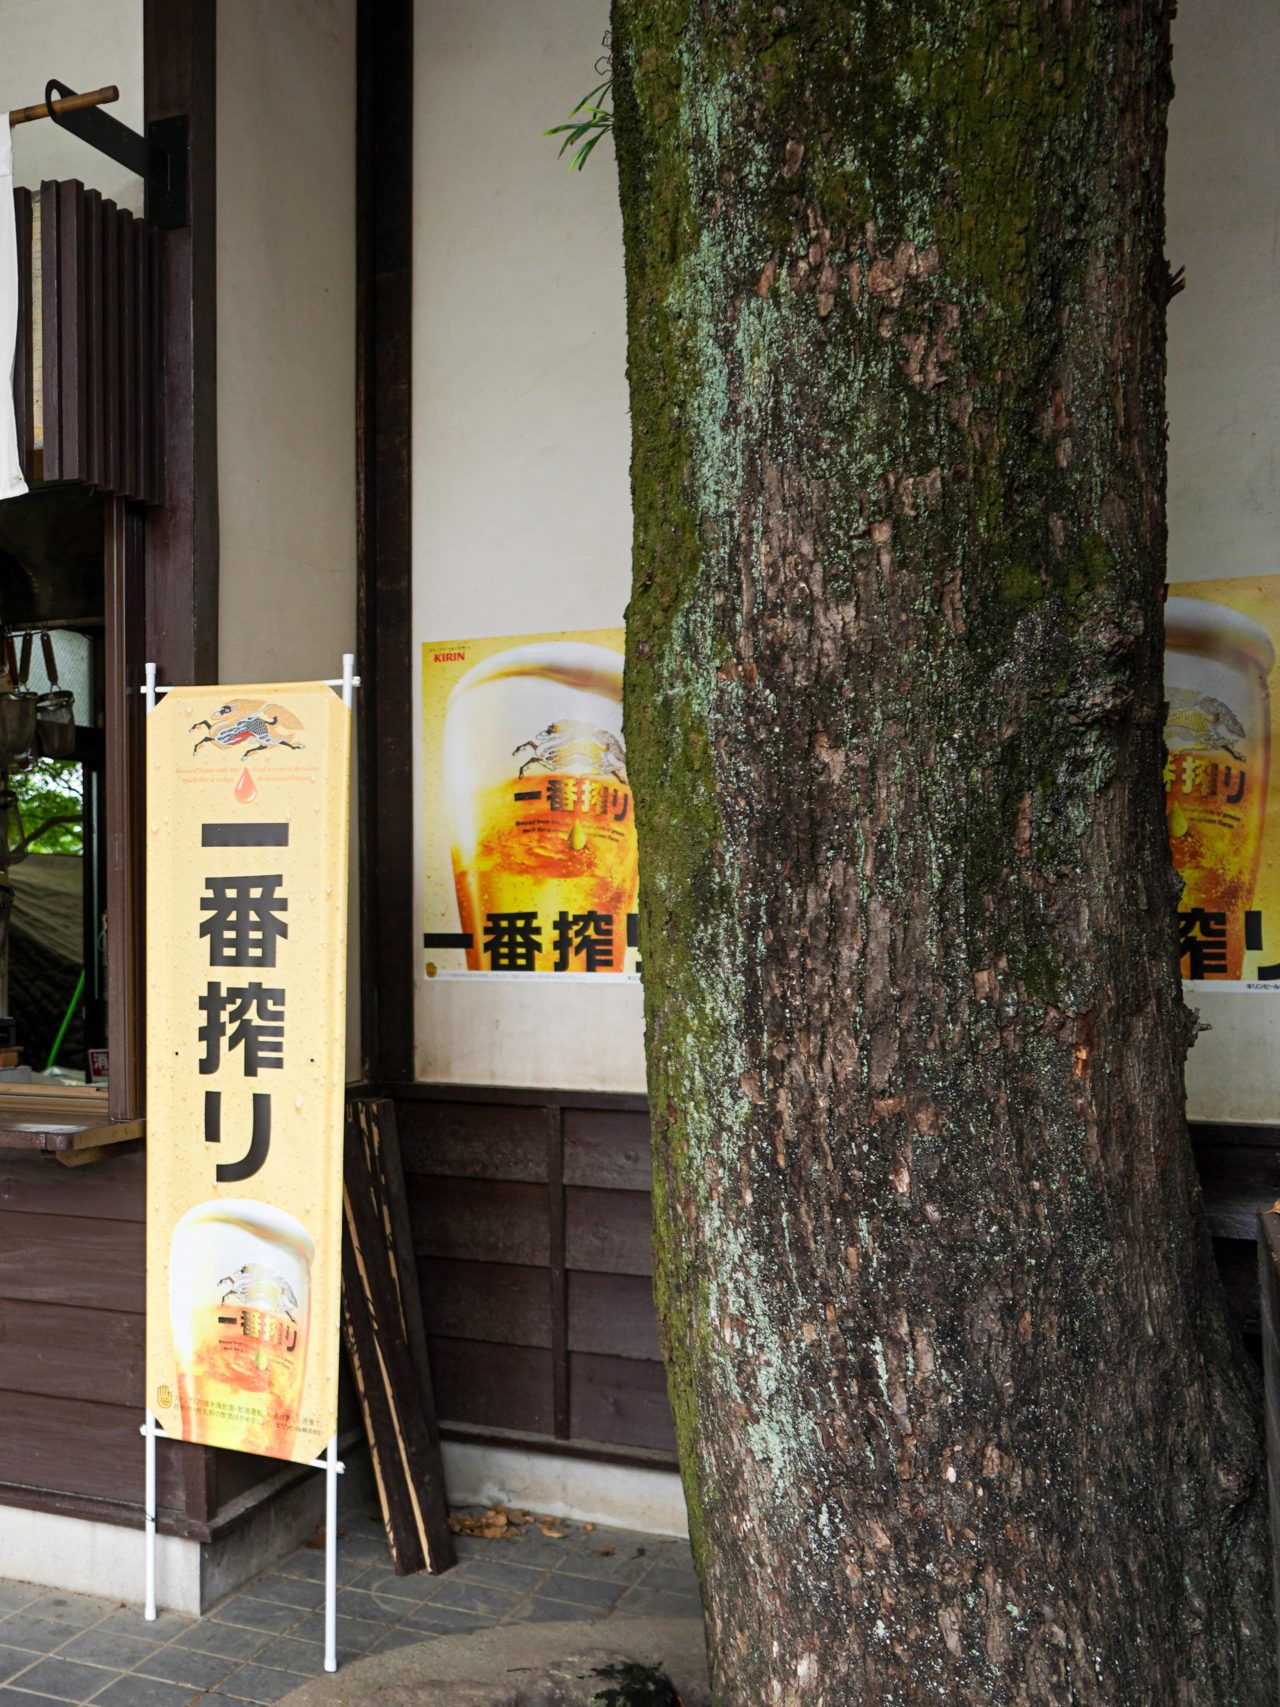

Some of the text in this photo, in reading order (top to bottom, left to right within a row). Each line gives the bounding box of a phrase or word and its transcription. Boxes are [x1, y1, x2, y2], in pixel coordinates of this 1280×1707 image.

[433, 652, 465, 663] KIRIN
[514, 778, 629, 821] 一番搾り
[198, 822, 289, 1183] 一番搾り
